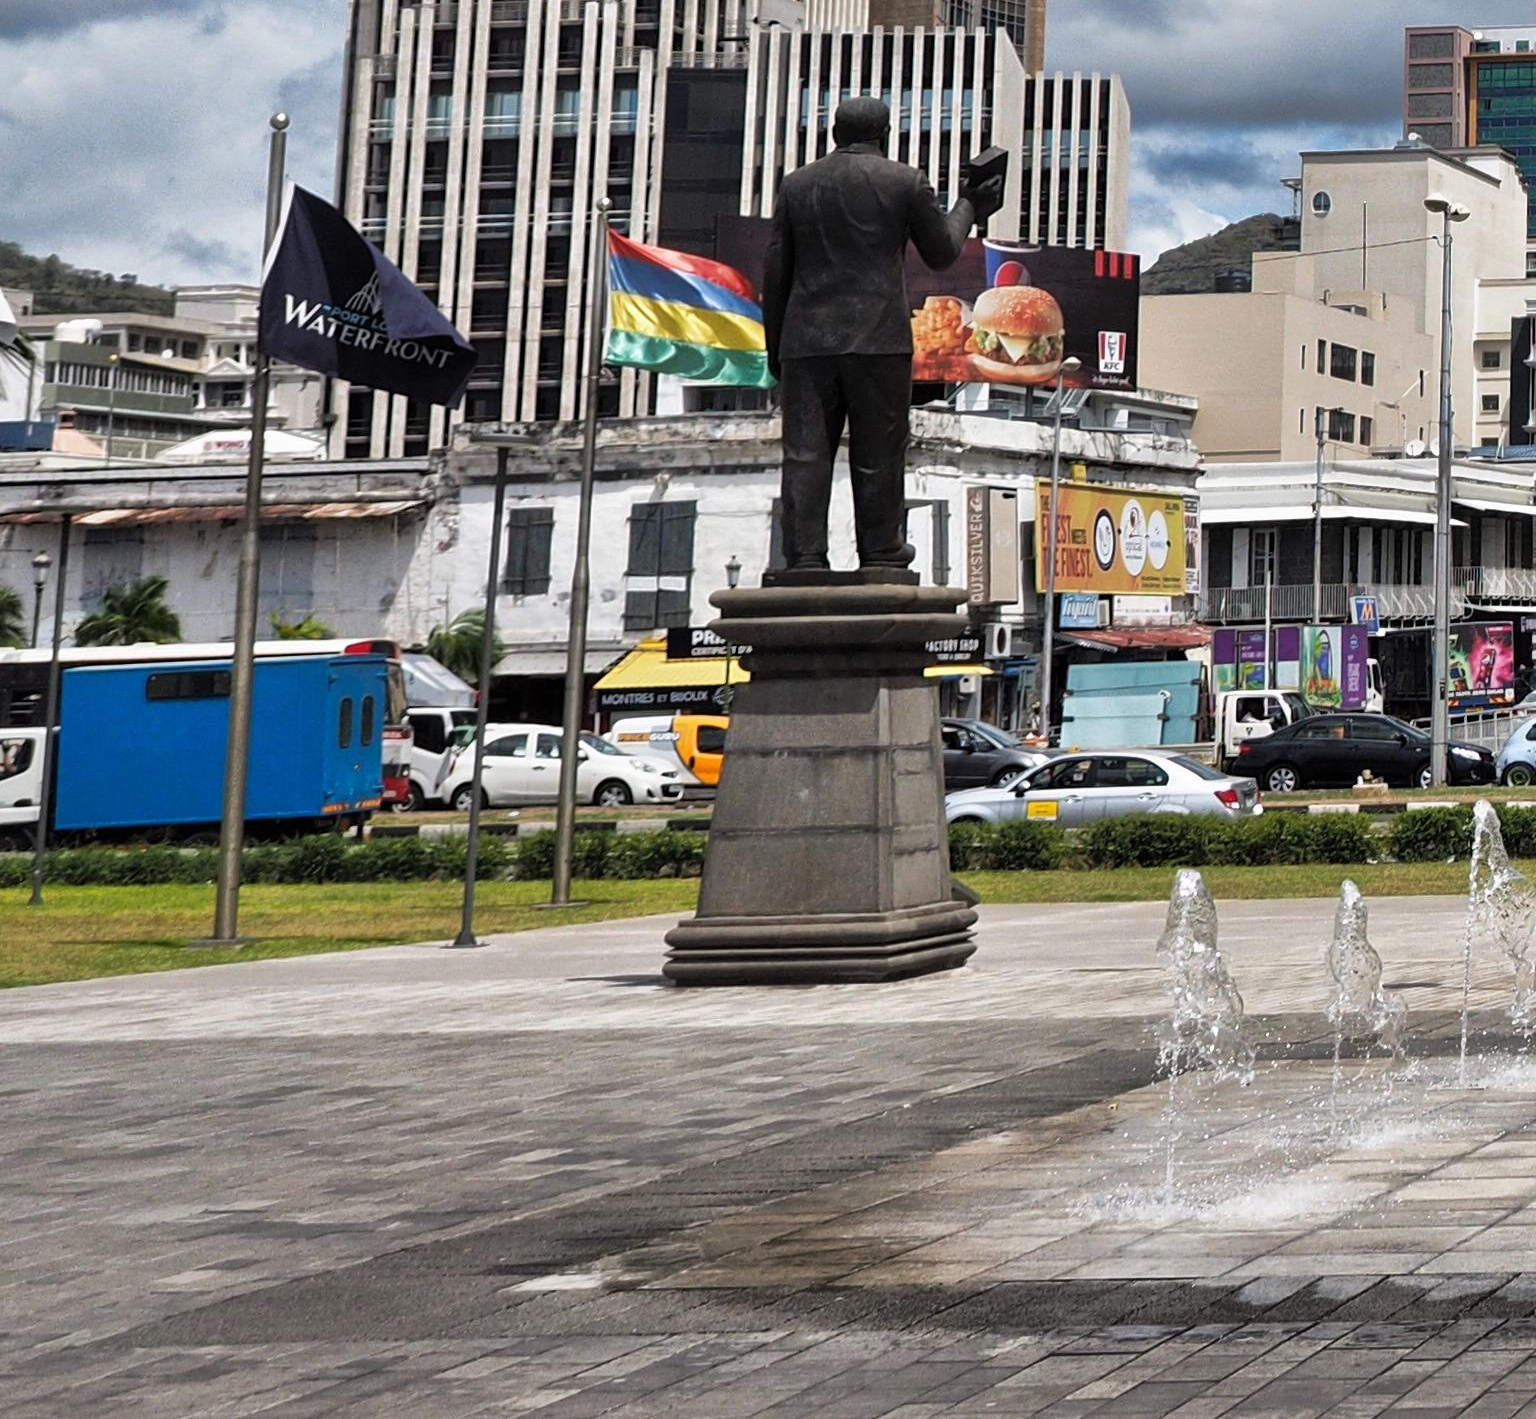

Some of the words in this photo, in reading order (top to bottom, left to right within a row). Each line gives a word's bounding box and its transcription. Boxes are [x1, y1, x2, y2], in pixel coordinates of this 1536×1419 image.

[284, 293, 454, 369] WATERFRONT
[1103, 361, 1121, 371] KFC
[1041, 514, 1072, 545] FIEST
[970, 513, 984, 603] QUIKSILVER
[601, 692, 654, 705] MONTRES
